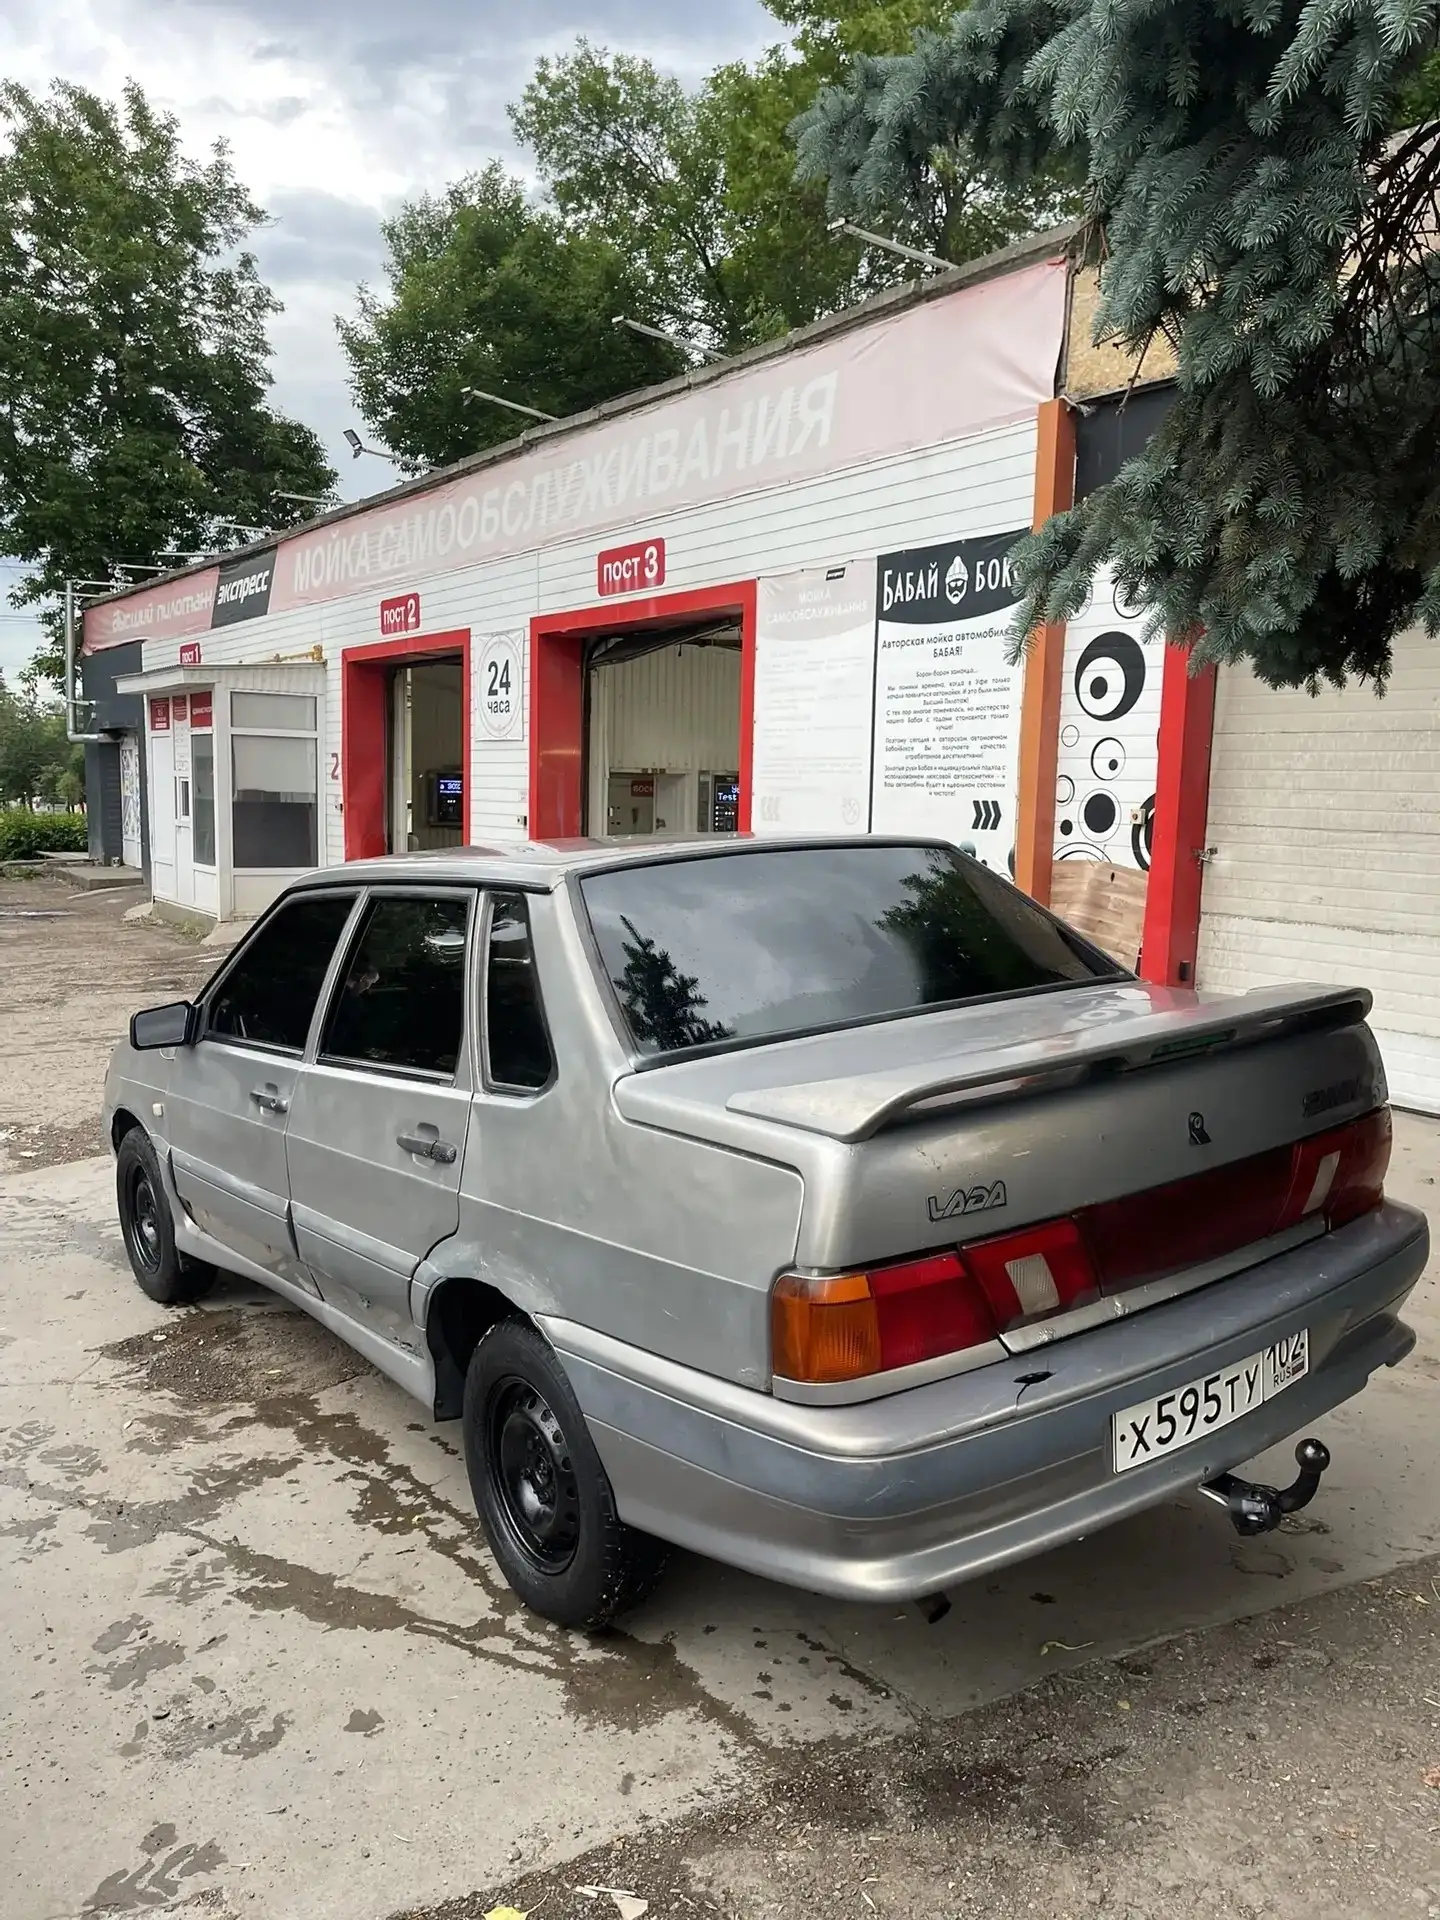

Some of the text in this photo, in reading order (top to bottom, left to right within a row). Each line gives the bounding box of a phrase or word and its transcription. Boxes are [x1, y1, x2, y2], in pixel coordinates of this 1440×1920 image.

[293, 370, 838, 593] МОЙКА САМООБСЛУЖИВАНИЯ
[603, 545, 659, 583] пост 3
[975, 556, 1016, 592] БОК
[217, 570, 270, 605] экспресс
[384, 598, 416, 625] пост 2
[194, 645, 199, 663] 1
[882, 637, 924, 649] Авторская
[926, 631, 954, 645] мойка
[933, 646, 963, 658] БАБАЯ!
[488, 659, 511, 696] 24
[488, 700, 510, 714] часа
[331, 752, 340, 780] 2
[718, 792, 737, 801] Test
[926, 1180, 1007, 1222] LADA
[1273, 1364, 1292, 1388] RUS
[1130, 1332, 1301, 1459] Х595ТУ 102
